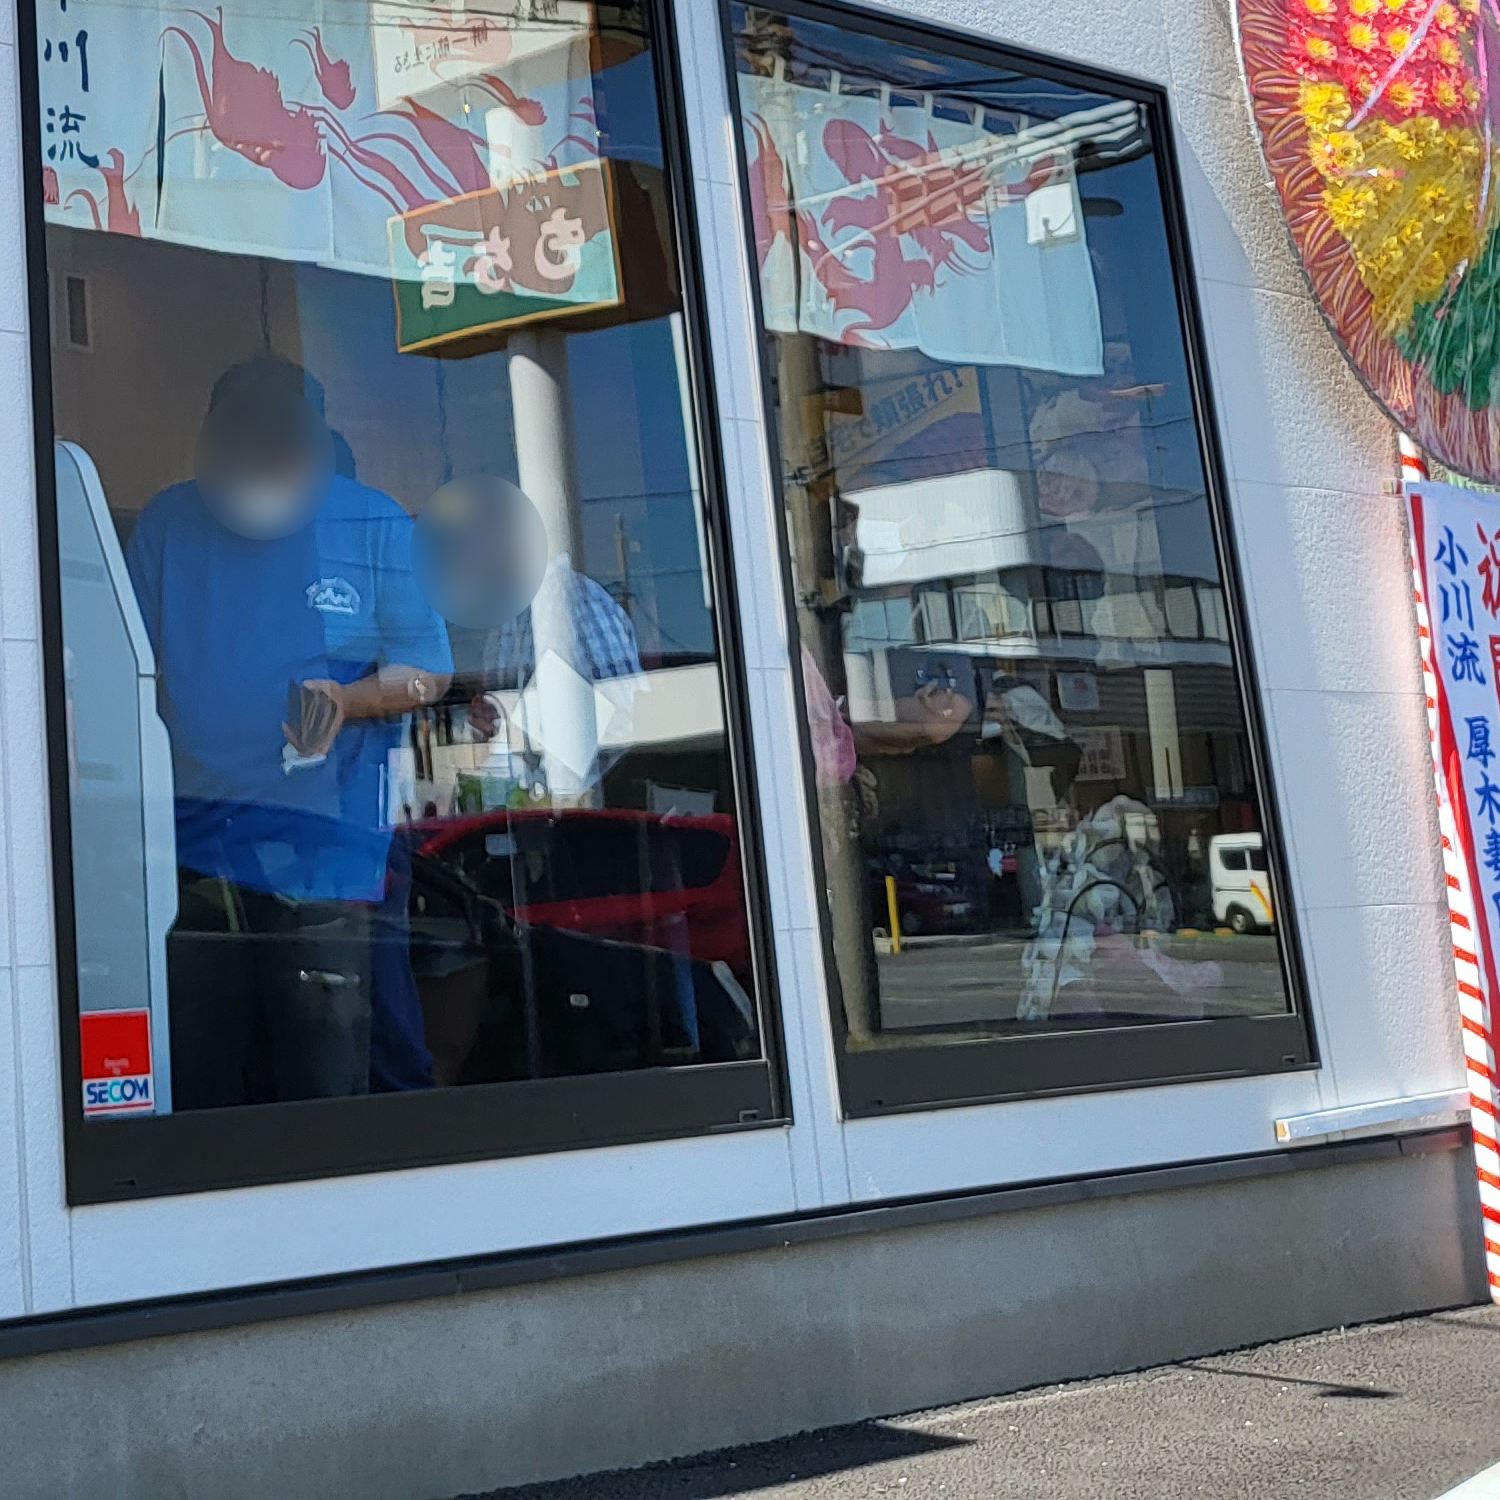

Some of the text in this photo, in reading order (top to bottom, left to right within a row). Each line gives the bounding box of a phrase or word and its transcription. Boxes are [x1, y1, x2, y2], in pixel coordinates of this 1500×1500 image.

[1433, 524, 1486, 686] 小川流
[86, 1079, 149, 1104] SECOM
